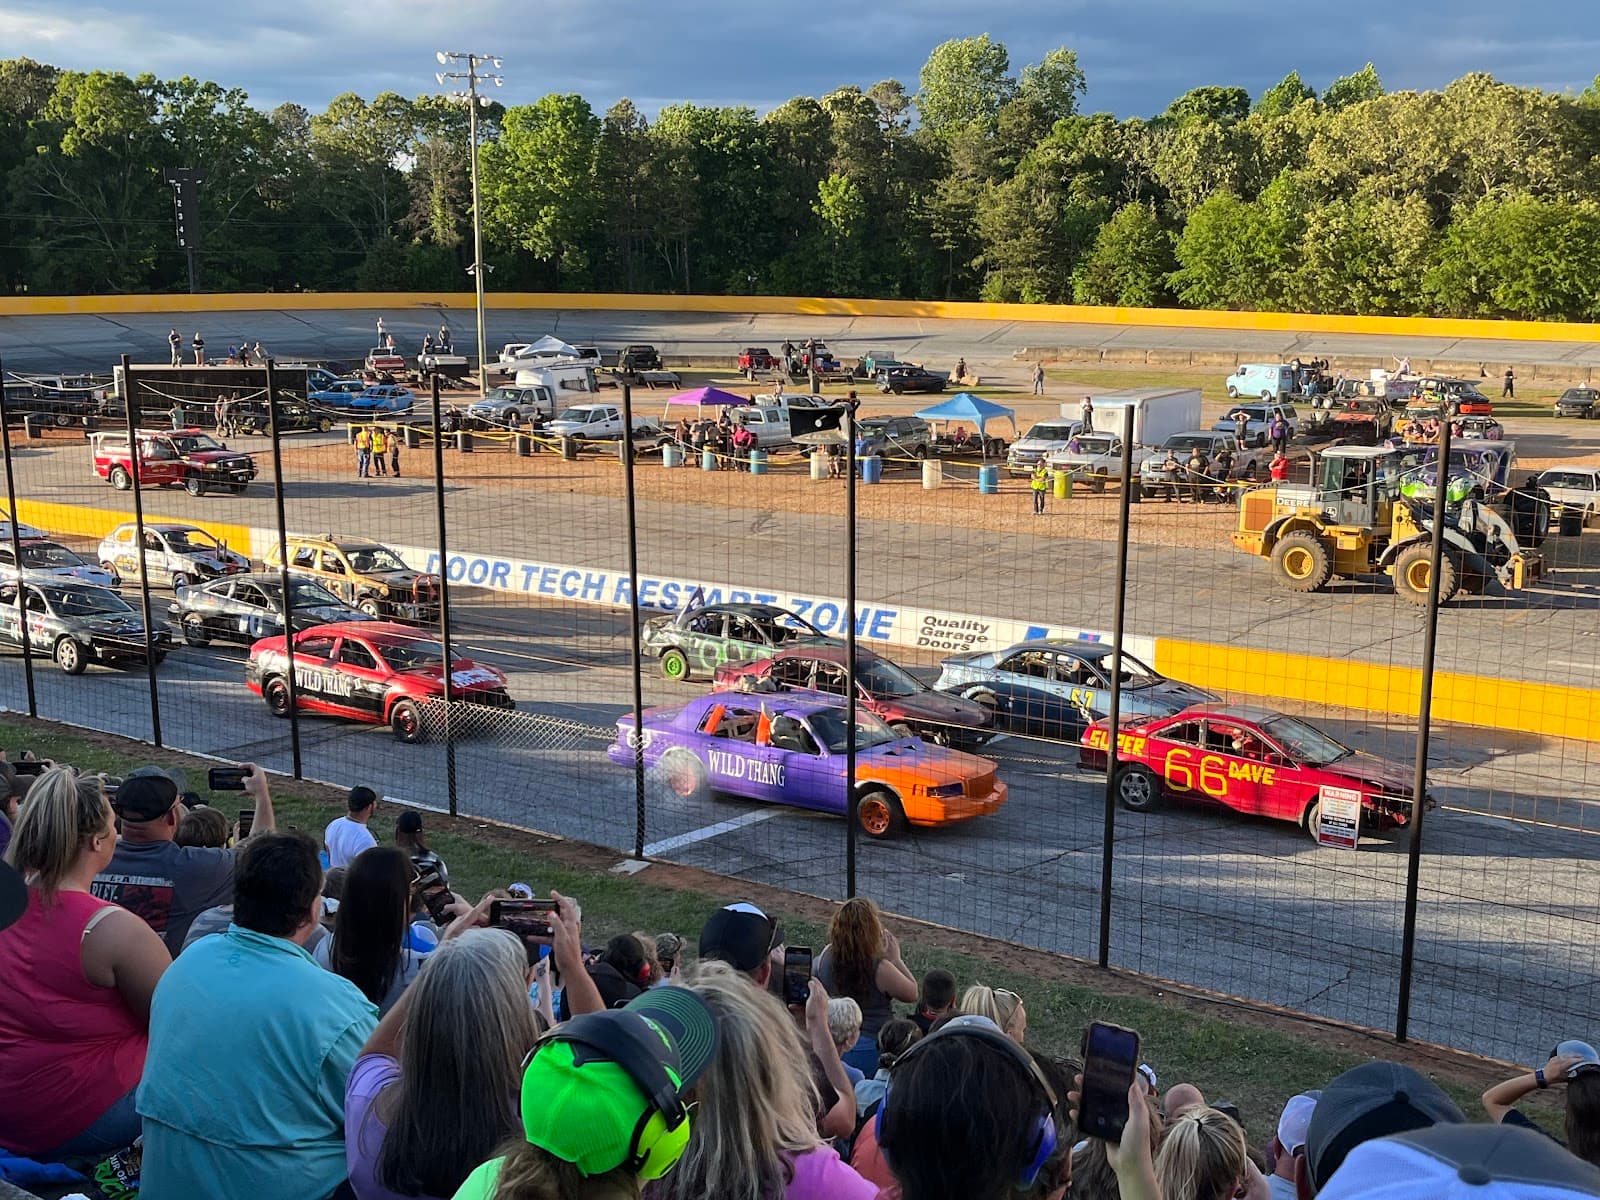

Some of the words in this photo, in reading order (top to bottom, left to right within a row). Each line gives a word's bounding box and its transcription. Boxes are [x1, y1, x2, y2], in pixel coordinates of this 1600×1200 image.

[1277, 497, 1310, 507] DEERE
[520, 564, 606, 600] TECH
[784, 599, 897, 640] ZONE
[923, 615, 990, 634] Quality
[917, 637, 971, 652] Doors
[919, 626, 989, 644] Garage
[295, 669, 321, 692] WILD
[323, 674, 352, 697] THANG
[708, 750, 745, 777] WILD
[747, 759, 785, 786] THANG
[1165, 748, 1227, 795] 66
[1228, 761, 1276, 785] DAVE
[1324, 789, 1357, 801] WARNING
